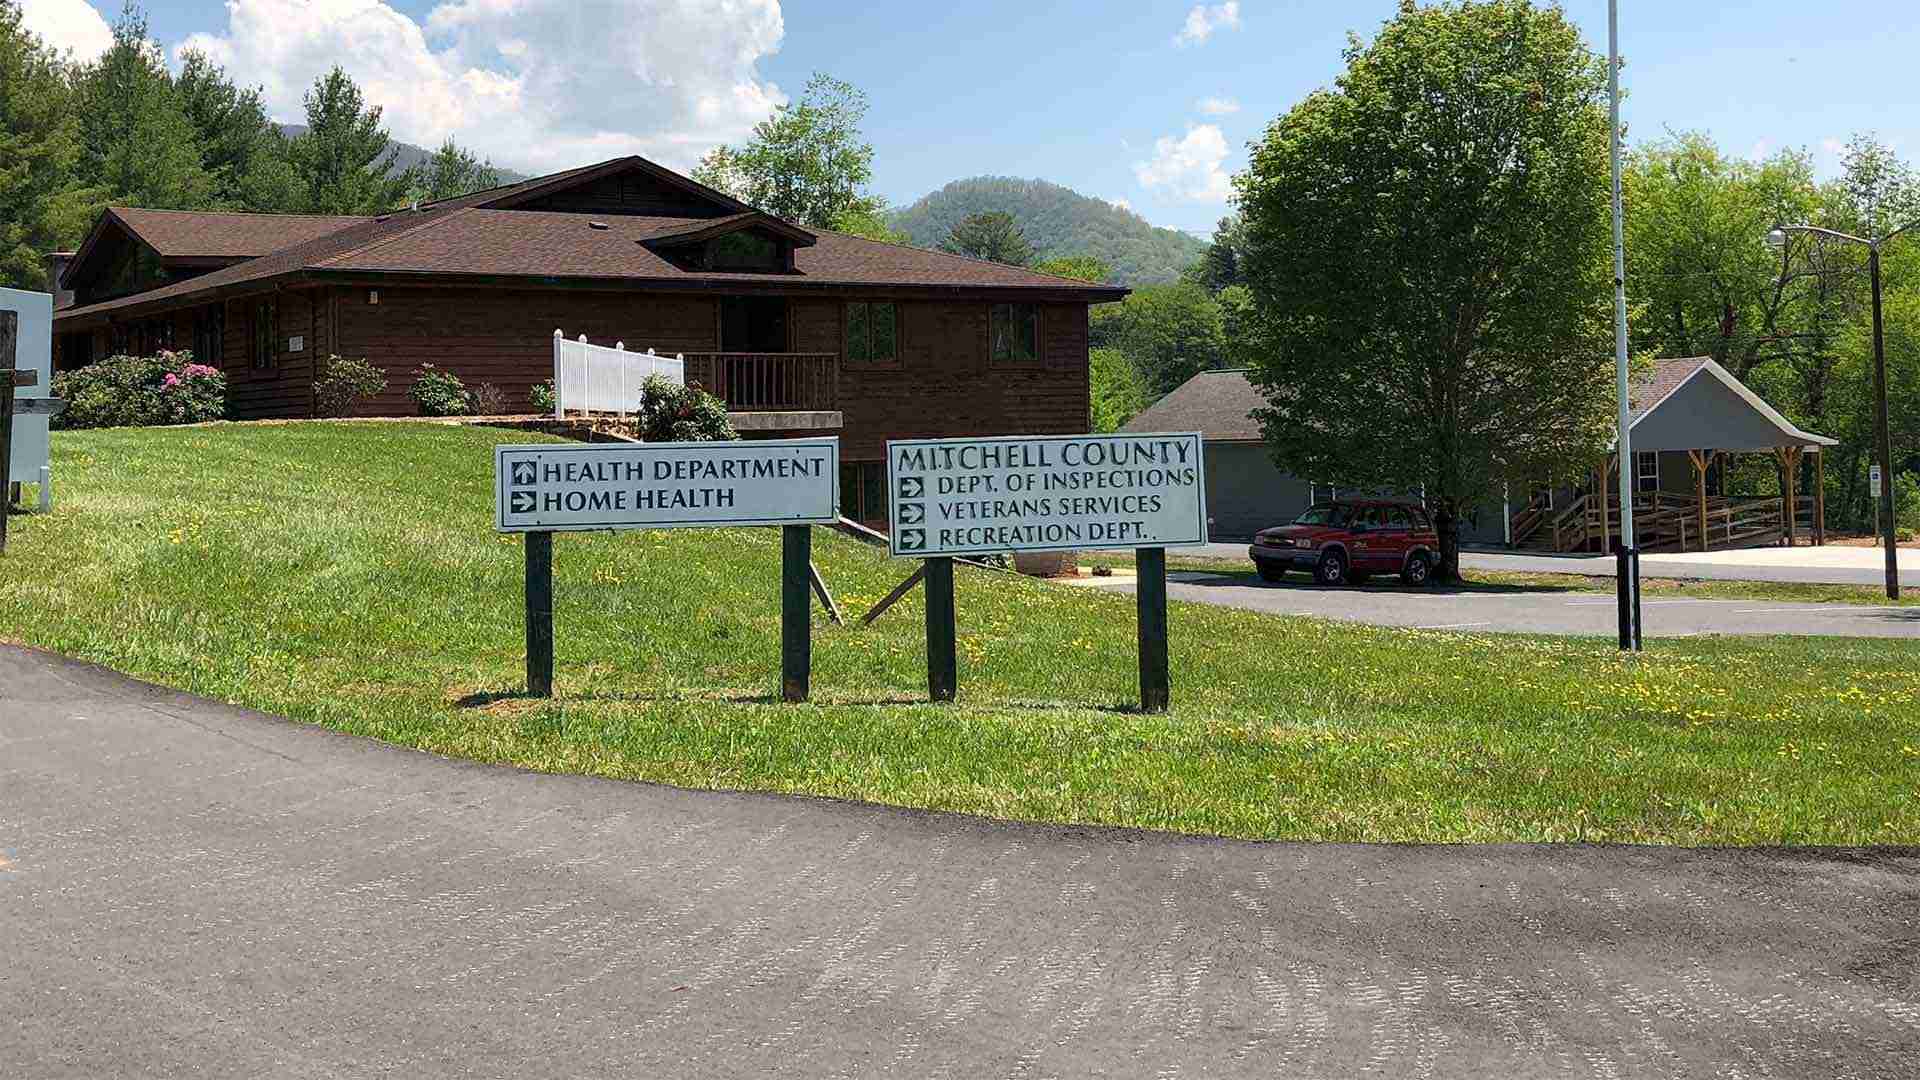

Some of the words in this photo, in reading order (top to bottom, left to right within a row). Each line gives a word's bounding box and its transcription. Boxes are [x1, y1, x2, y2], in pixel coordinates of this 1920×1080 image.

[898, 444, 1053, 472] MITCHELL
[1061, 441, 1191, 467] COUNTY
[543, 461, 644, 483] HEALTH
[654, 458, 825, 481] DEPARTMENT
[938, 474, 998, 495] DEPT.
[1006, 473, 1036, 491] OF
[1043, 468, 1195, 490] INSPECTIONS
[543, 490, 627, 512] HOME
[636, 488, 735, 510] HEALTH
[939, 499, 1050, 521] VETERANS
[1059, 495, 1161, 516] SERVICES
[939, 523, 1081, 547] RECREATION
